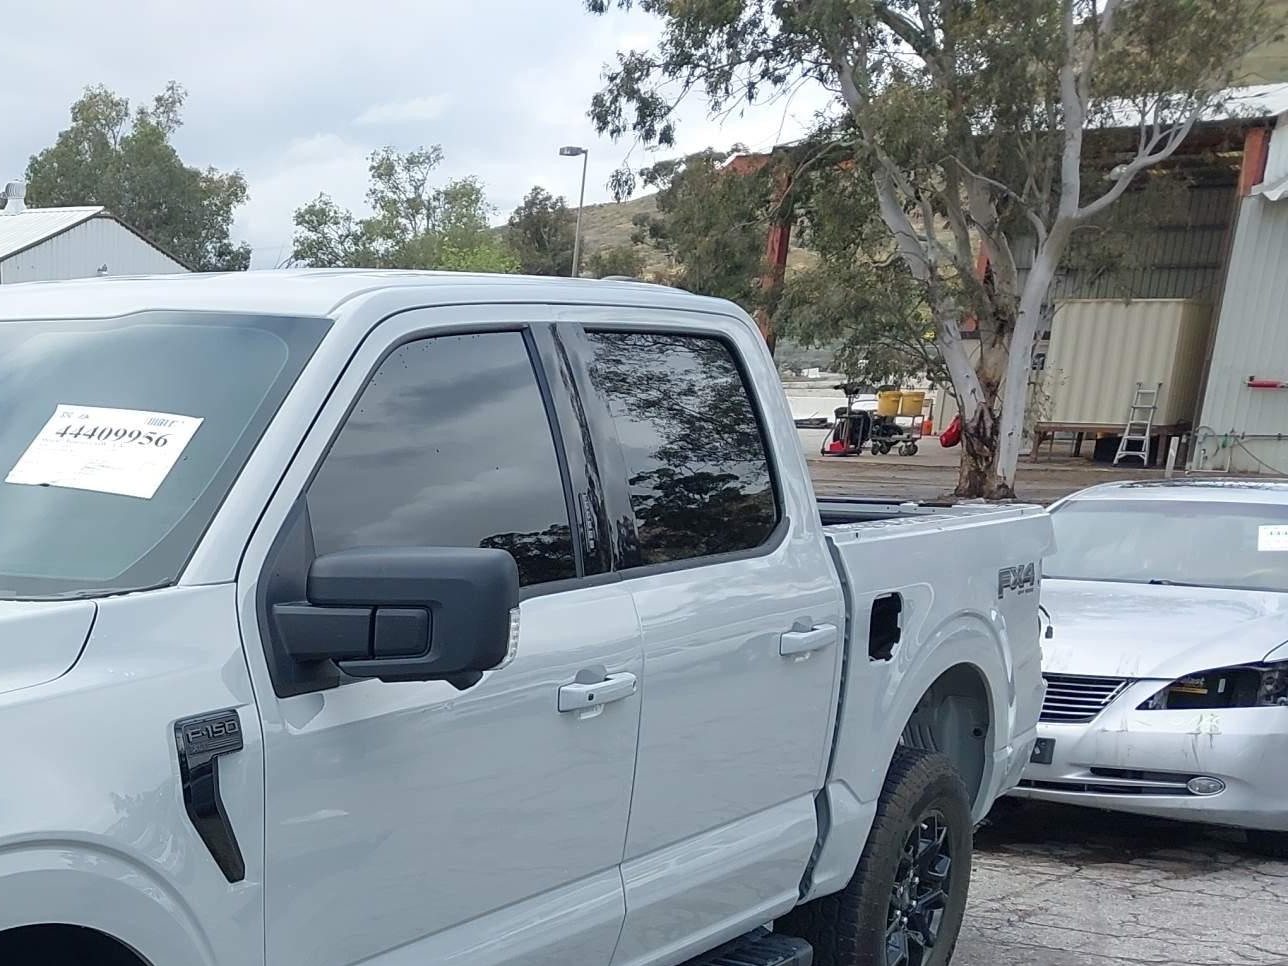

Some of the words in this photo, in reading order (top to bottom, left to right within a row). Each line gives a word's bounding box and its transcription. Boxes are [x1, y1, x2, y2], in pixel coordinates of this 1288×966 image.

[55, 424, 174, 448] 44409956
[998, 562, 1035, 599] FX4
[187, 720, 239, 743] F-150
